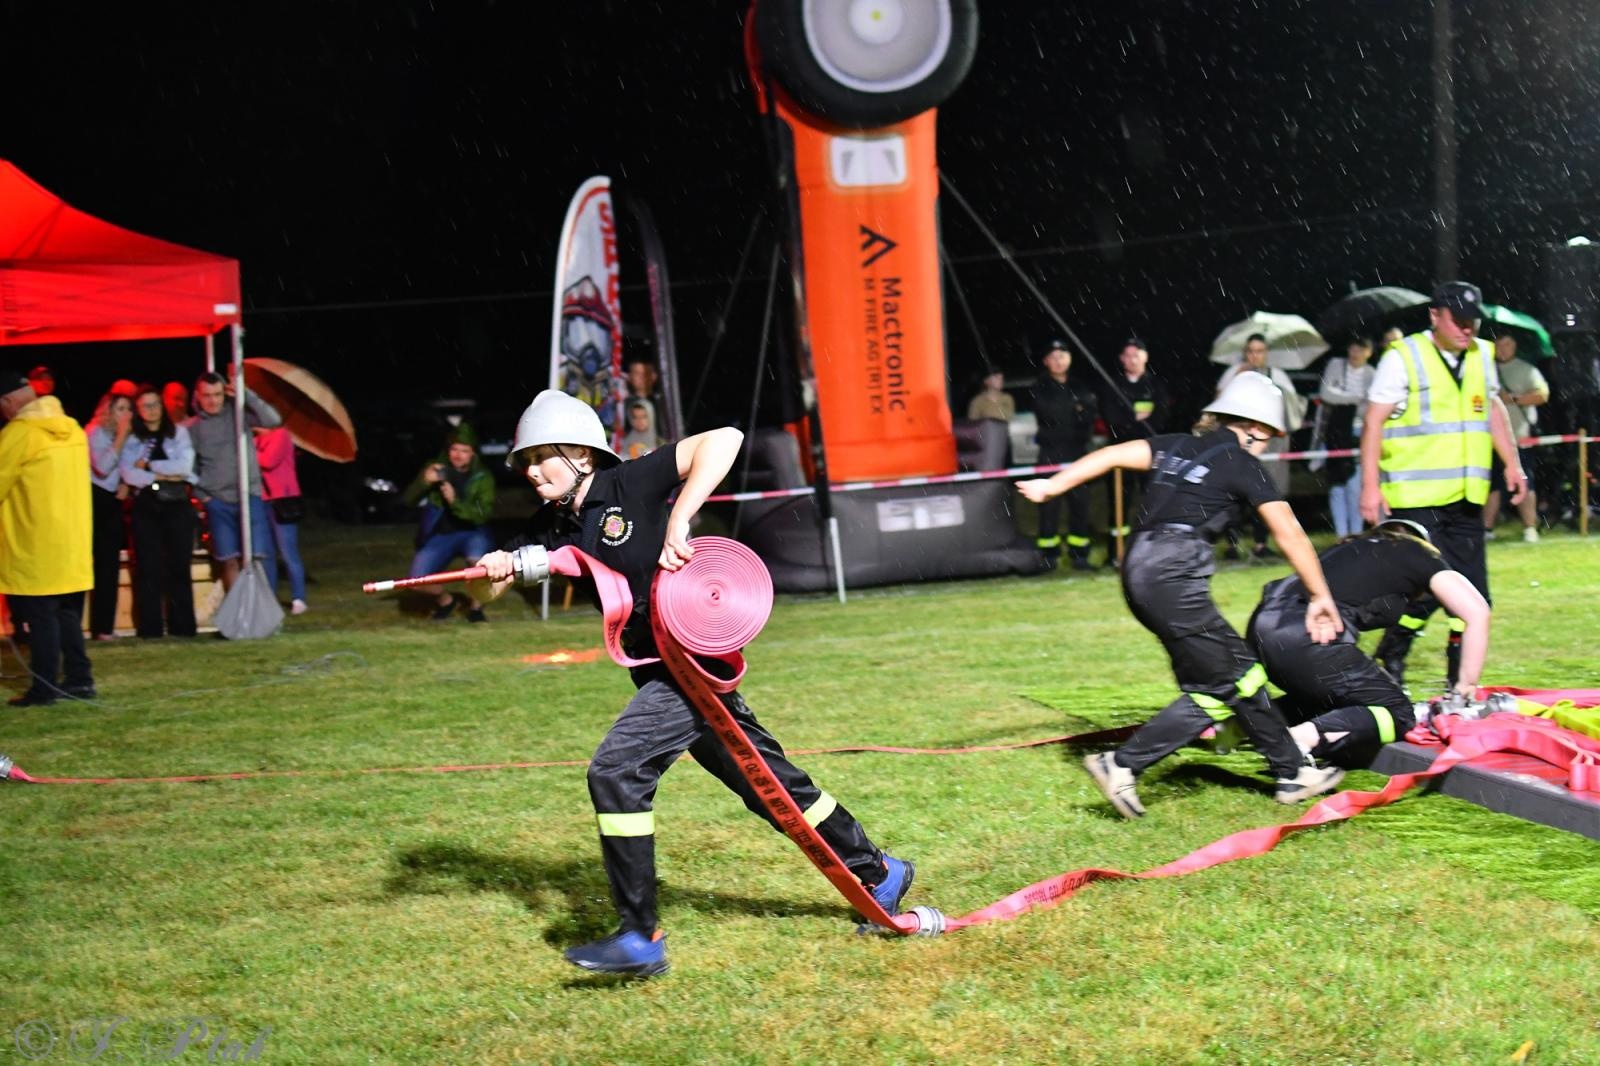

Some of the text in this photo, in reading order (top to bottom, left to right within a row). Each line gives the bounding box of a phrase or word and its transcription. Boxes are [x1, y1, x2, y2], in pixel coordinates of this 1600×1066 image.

[864, 278, 876, 290] M
[865, 299, 879, 334] FIRE
[866, 339, 881, 362] AG
[880, 277, 911, 411] Mactronic
[869, 394, 884, 414] EX
